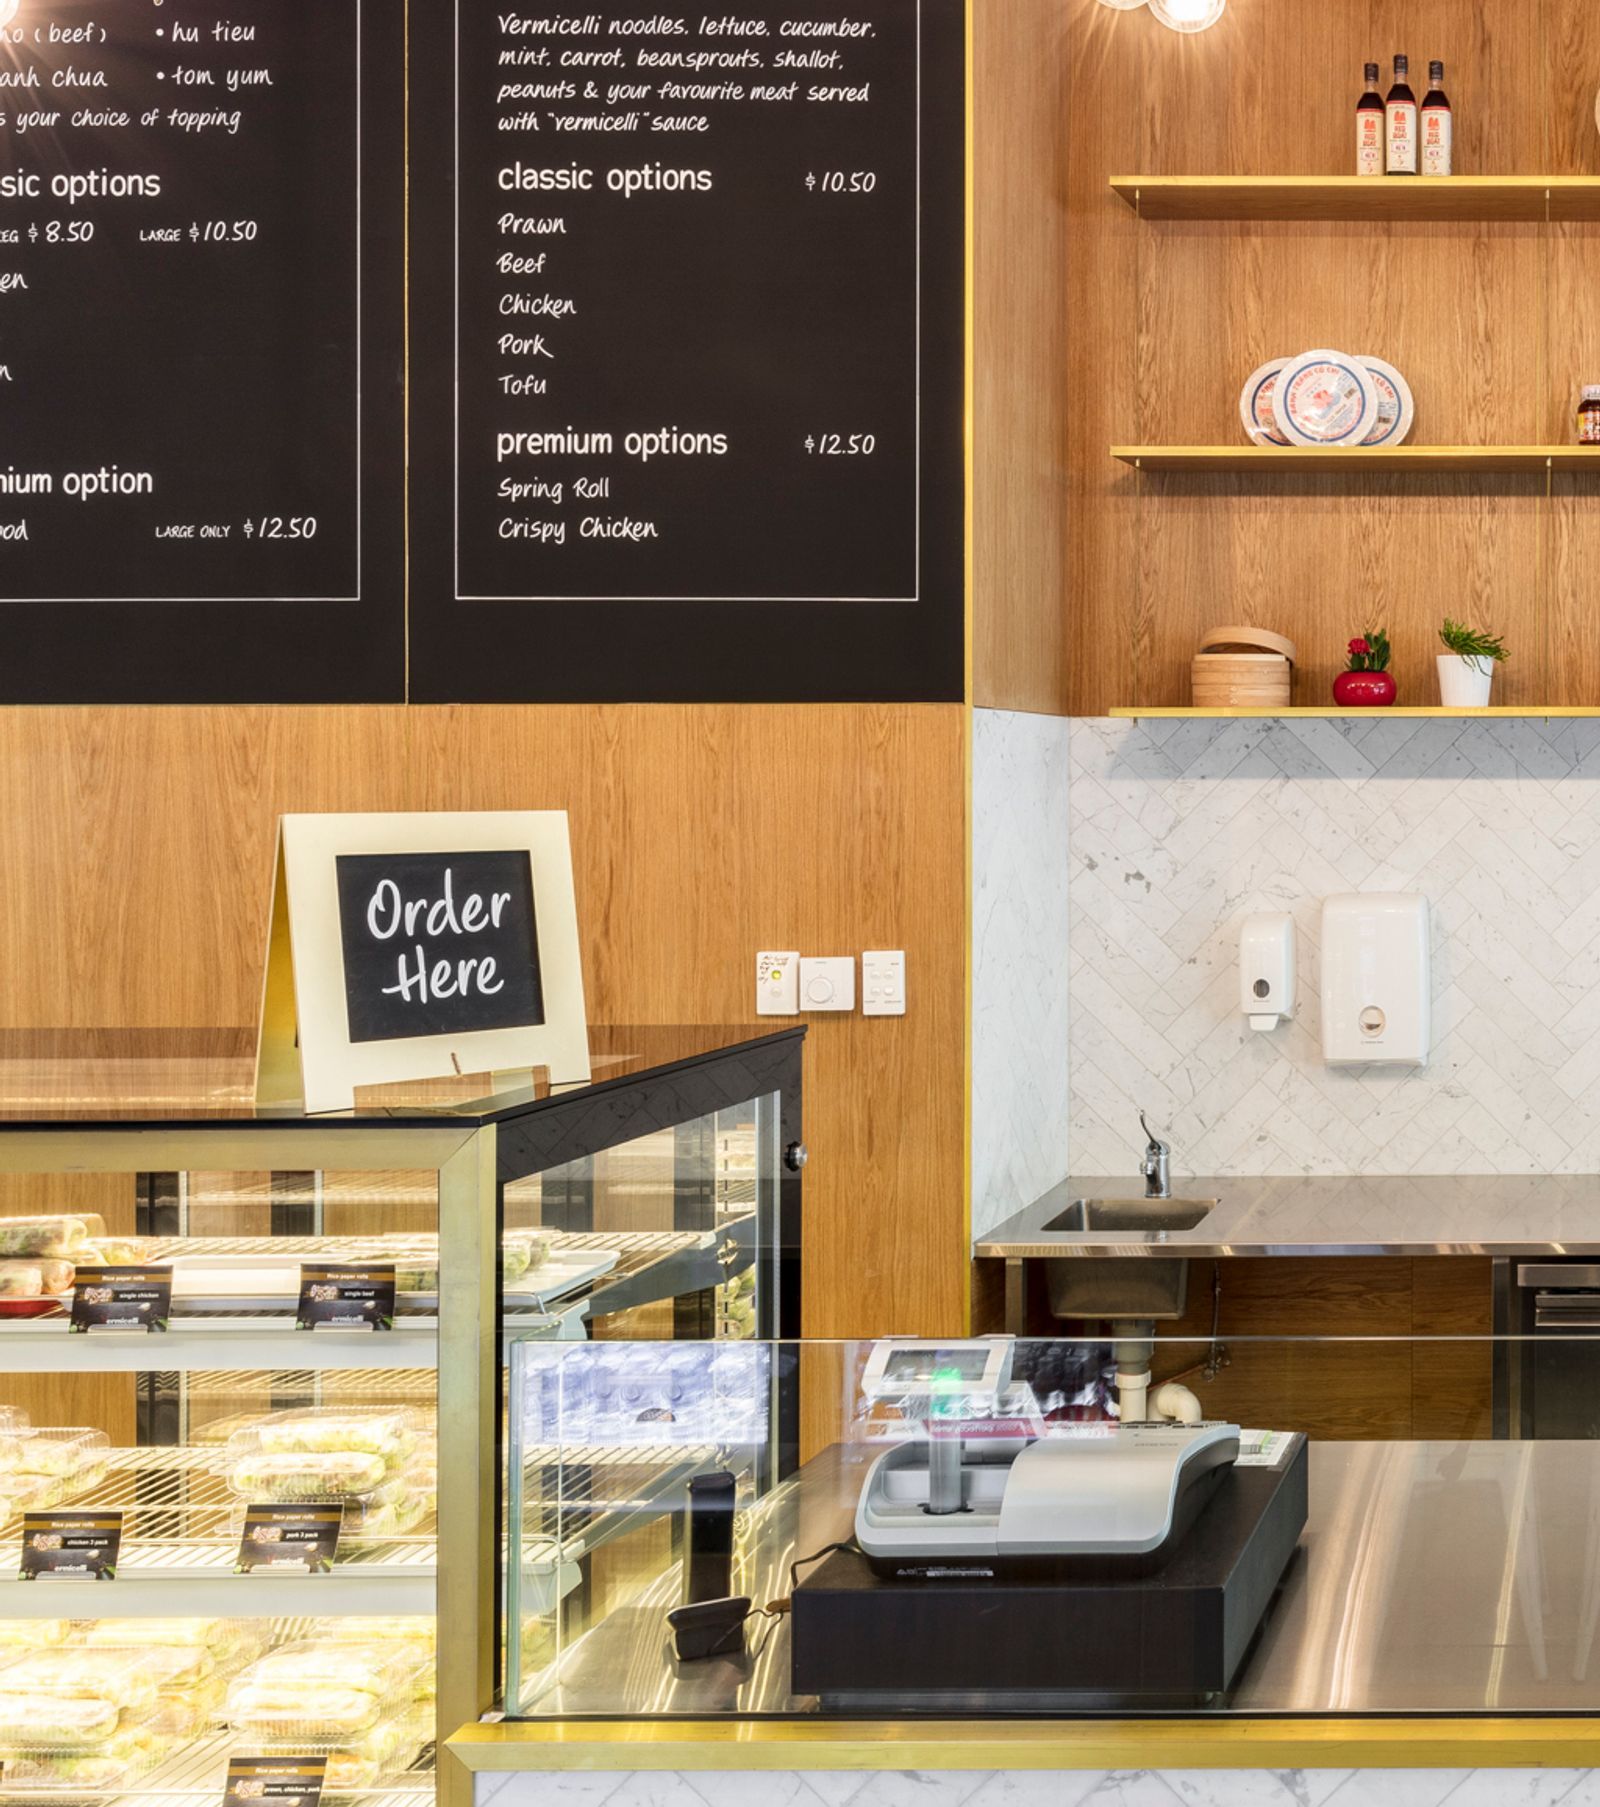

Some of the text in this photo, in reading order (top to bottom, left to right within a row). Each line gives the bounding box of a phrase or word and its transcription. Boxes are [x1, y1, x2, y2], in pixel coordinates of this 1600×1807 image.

[172, 21, 255, 42] hu tieu
[499, 12, 602, 35] Vermicelli
[52, 66, 108, 87] chua
[172, 66, 273, 91] tom yum
[497, 80, 869, 104] peanuts & your favourite meat served
[16, 111, 61, 134] your
[71, 108, 131, 127] choice
[141, 108, 160, 127] of
[168, 108, 242, 134] topping
[498, 112, 539, 130] with
[650, 116, 710, 131] sauce
[52, 168, 161, 204] options
[498, 161, 713, 198] classic options
[805, 172, 876, 192] $10.50
[140, 221, 257, 242] LARGE $10.50
[498, 213, 567, 234] Prawn
[496, 252, 547, 273] Beef
[499, 294, 577, 319] Chicken
[498, 334, 555, 358] Pork
[498, 375, 547, 395] Tofu
[497, 425, 728, 462] premium options
[805, 434, 875, 454] $12.50
[63, 465, 153, 501] option
[498, 477, 609, 504] Spring Roll
[155, 517, 317, 539] LARGE ONLY $12.50
[498, 517, 659, 544] Crispy Chicken
[366, 867, 511, 940] Order
[381, 944, 505, 1005] Here
